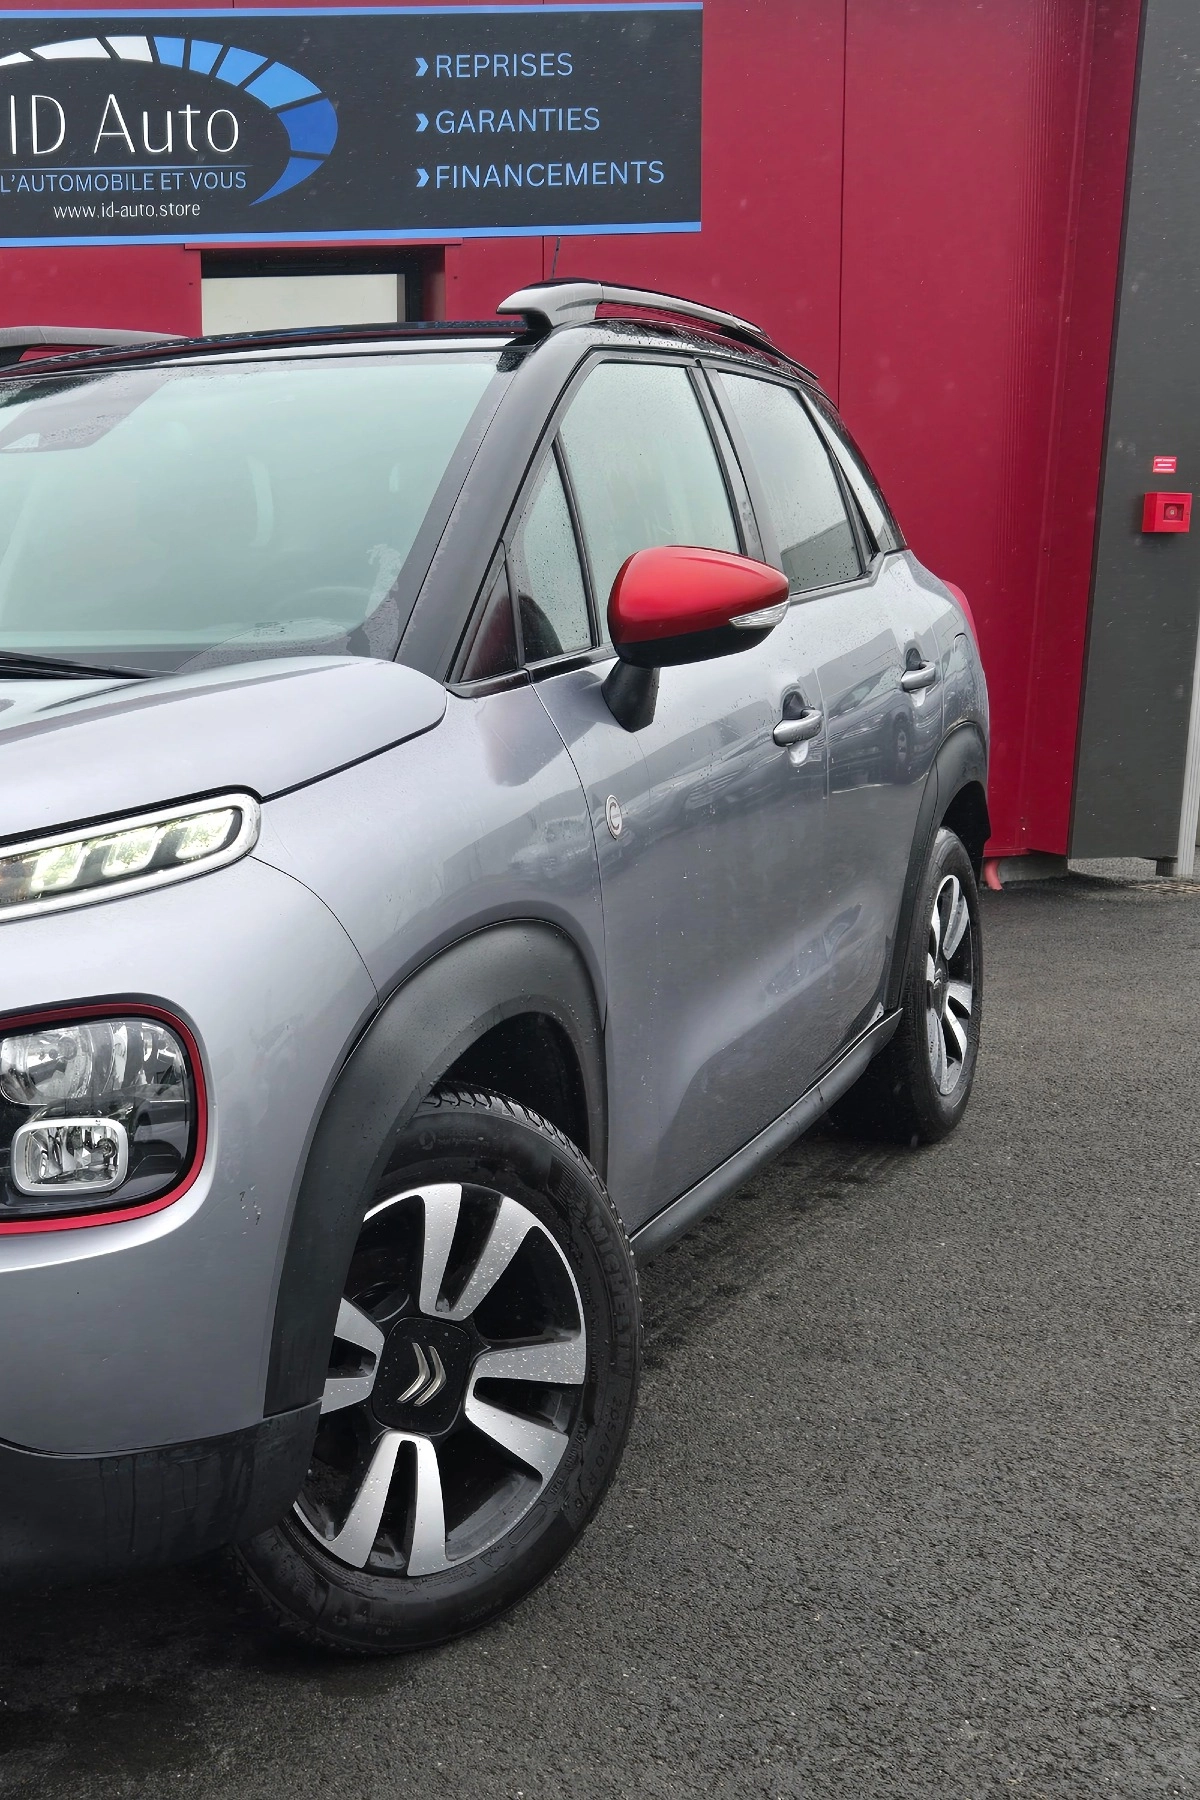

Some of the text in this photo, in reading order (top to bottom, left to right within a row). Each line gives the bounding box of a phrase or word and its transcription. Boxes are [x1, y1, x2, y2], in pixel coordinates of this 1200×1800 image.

[435, 52, 574, 79] REPRISES
[9, 93, 240, 155] ID Auto
[435, 106, 601, 134] GARANTIES
[161, 173, 184, 191] ET
[189, 171, 247, 190] VOUS
[435, 160, 666, 190] FINANCEMENTS
[53, 201, 201, 219] www.id-auto.store
